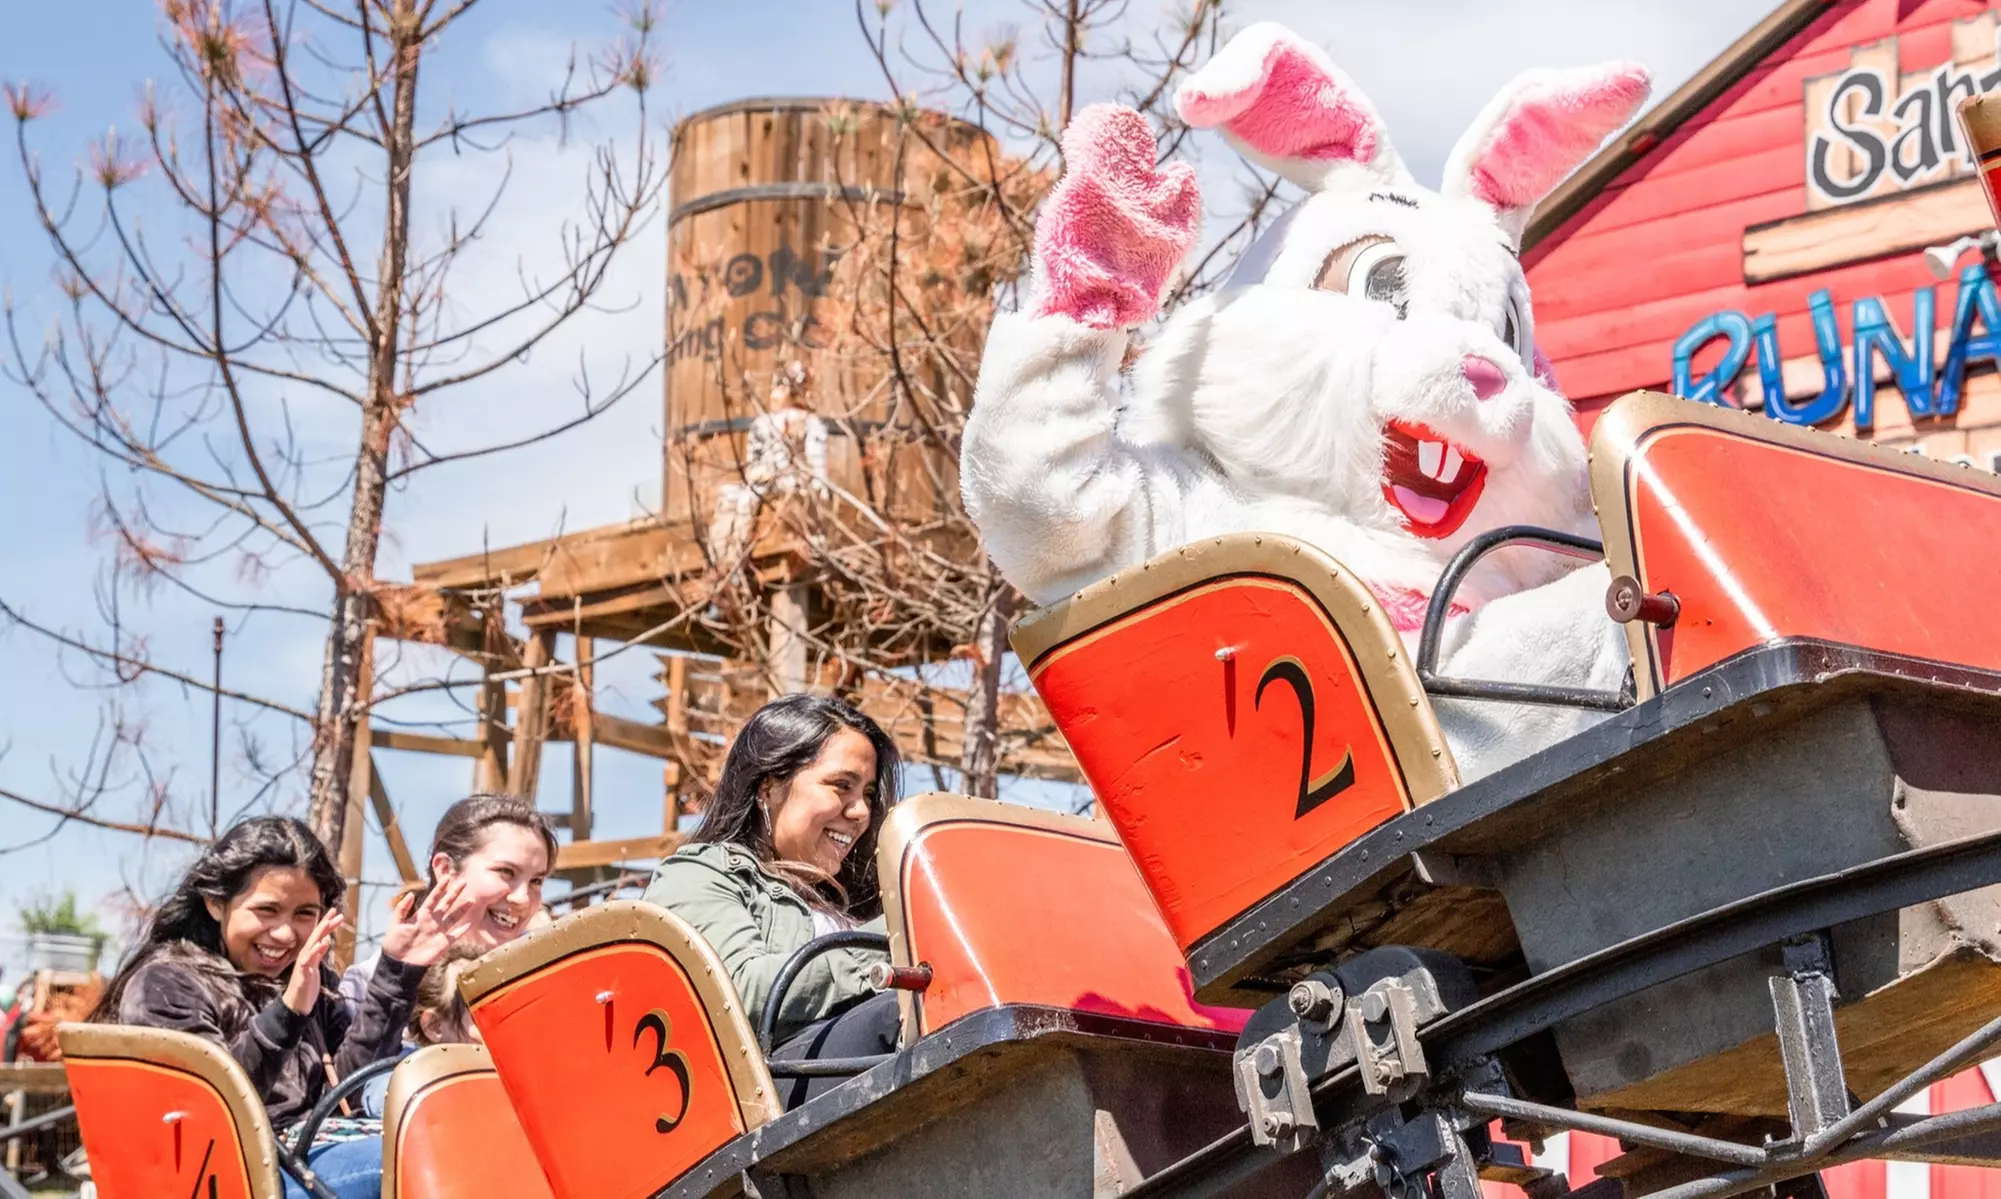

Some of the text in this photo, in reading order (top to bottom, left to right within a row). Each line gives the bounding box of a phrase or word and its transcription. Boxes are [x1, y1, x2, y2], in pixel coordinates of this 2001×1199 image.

[1812, 68, 2001, 198] San
[1672, 263, 2001, 427] RUNA
[1255, 655, 1355, 821] 2
[633, 1008, 694, 1134] 3
